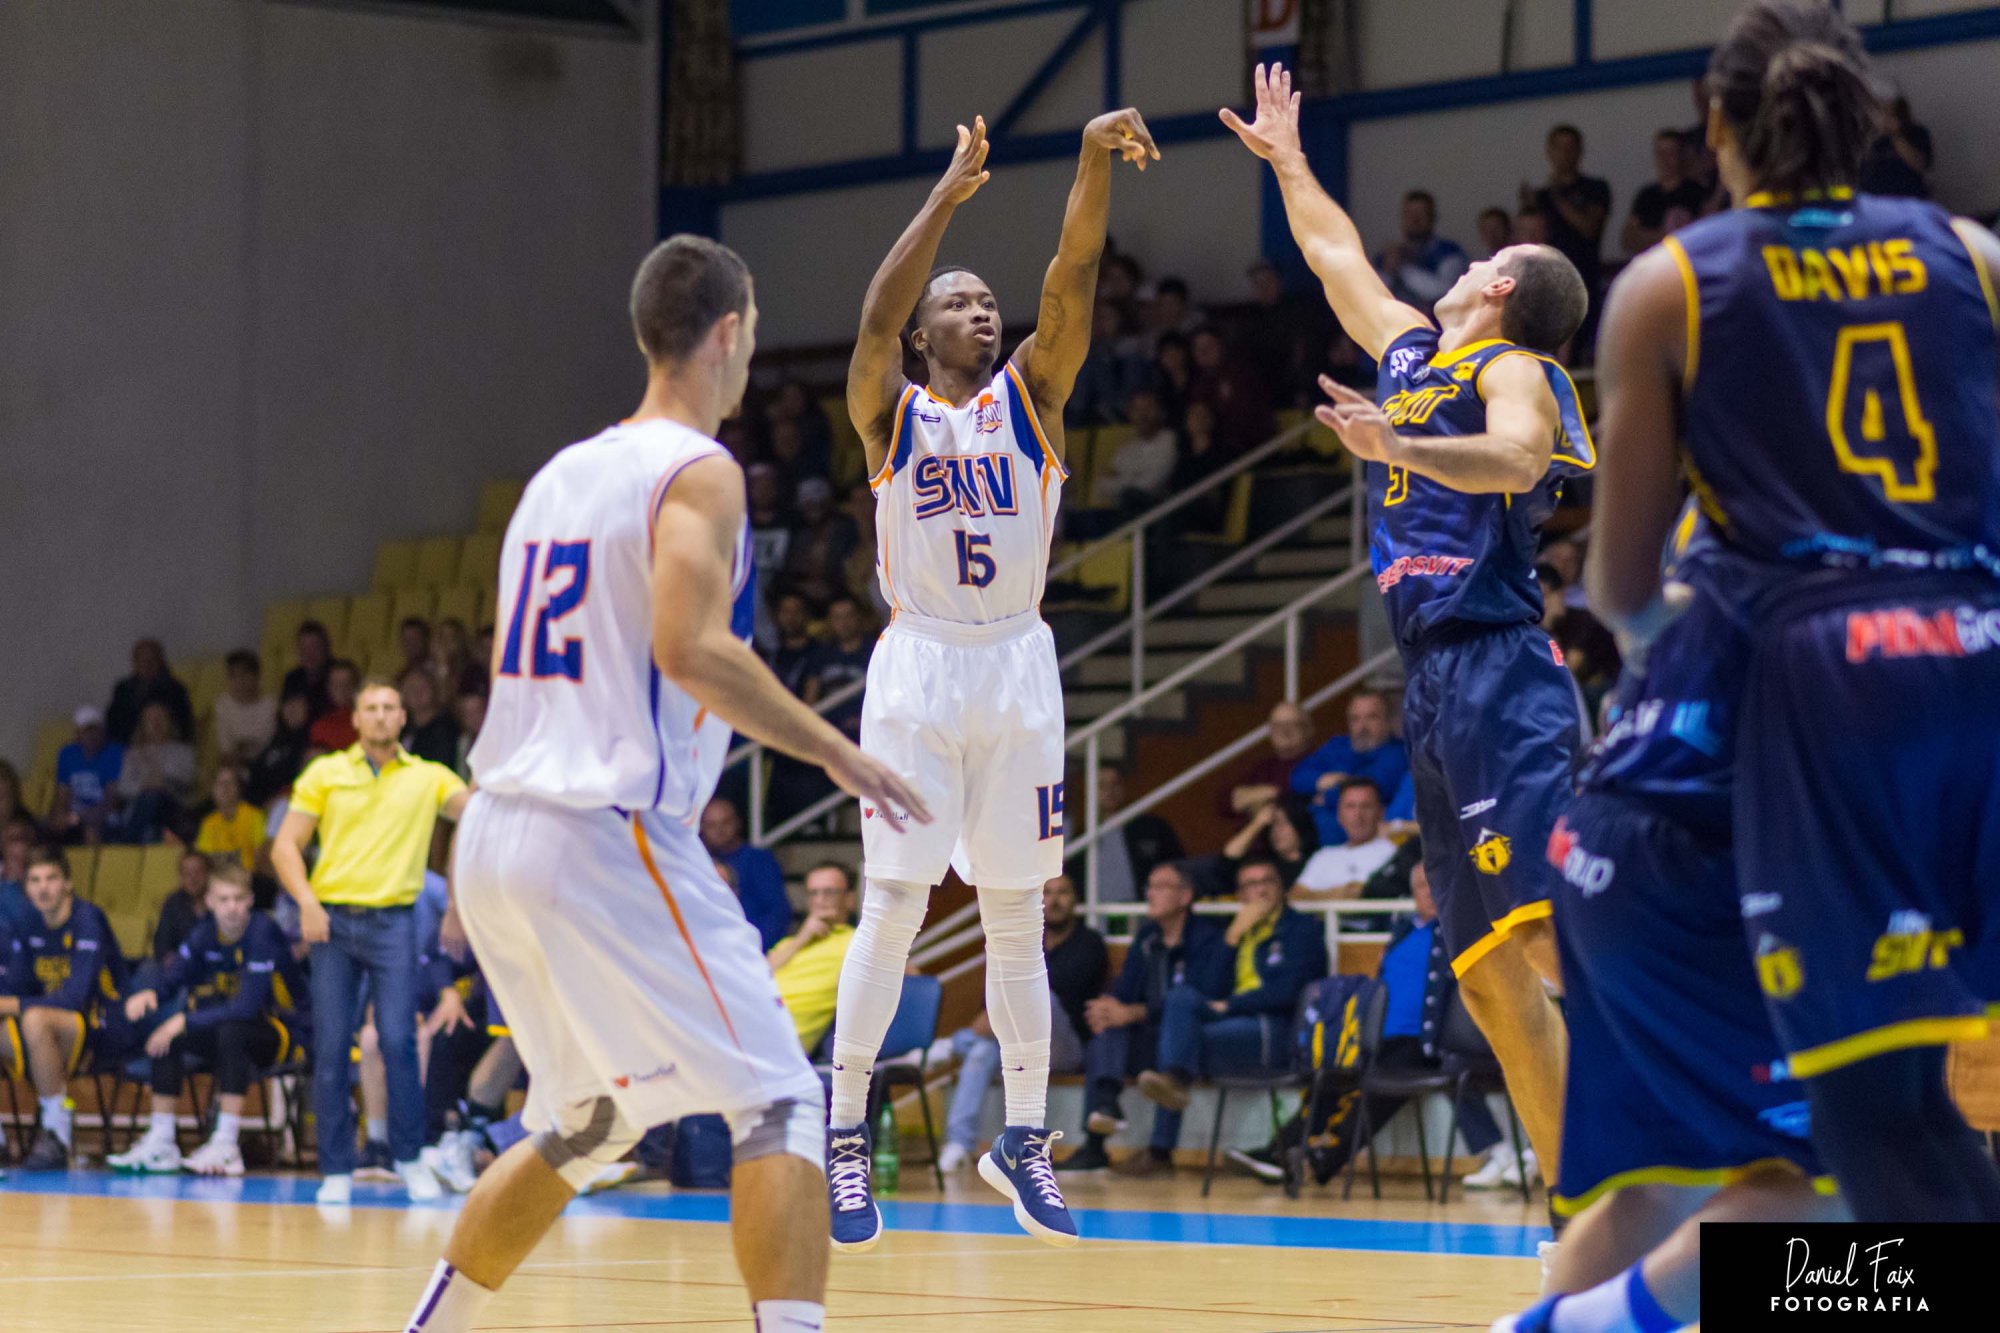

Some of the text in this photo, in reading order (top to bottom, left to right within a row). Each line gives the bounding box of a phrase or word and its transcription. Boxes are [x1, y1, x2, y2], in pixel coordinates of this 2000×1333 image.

[1762, 239, 1928, 301] DAVIS
[1826, 322, 1938, 502] 4
[952, 529, 997, 588] 15
[498, 538, 592, 684] 12
